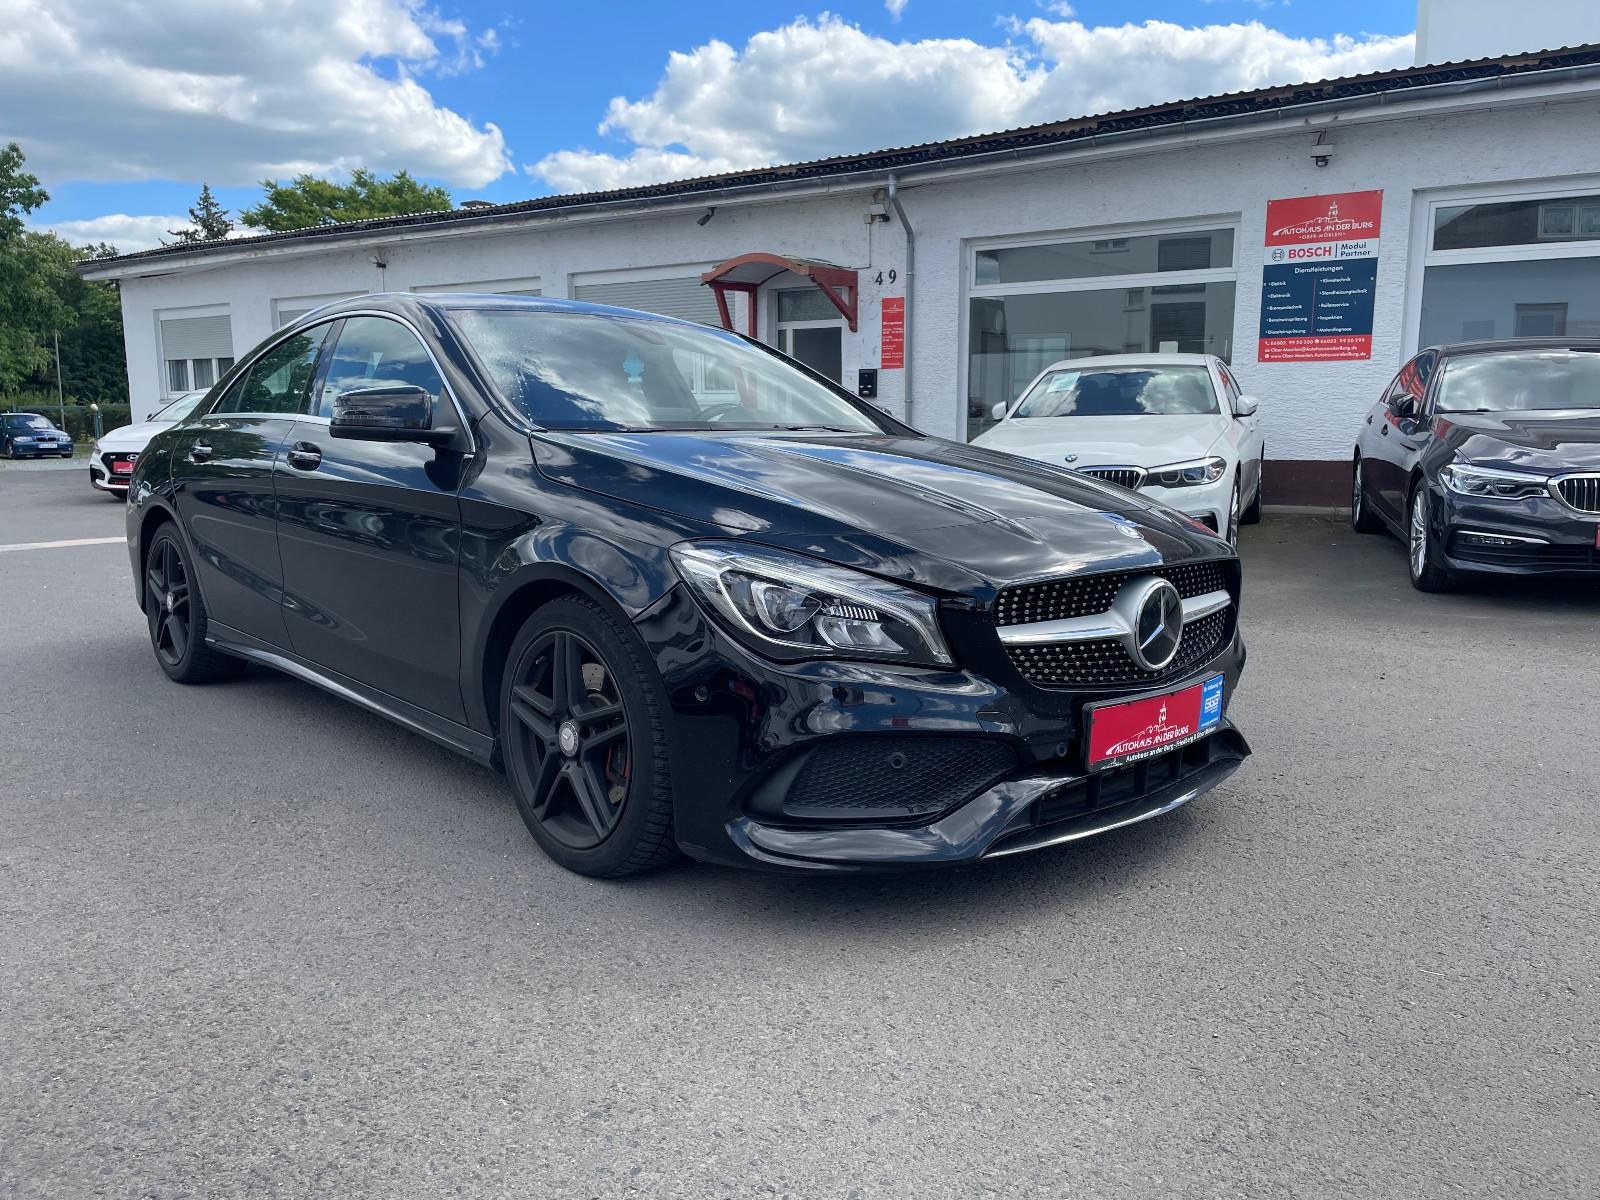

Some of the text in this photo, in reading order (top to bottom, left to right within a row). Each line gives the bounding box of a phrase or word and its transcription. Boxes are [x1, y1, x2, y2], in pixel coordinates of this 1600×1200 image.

[1281, 225, 1321, 236] AUTOHAUS
[1352, 221, 1373, 230] BURG
[1288, 246, 1332, 258] BOSCH
[1341, 242, 1366, 250] Modul
[875, 270, 896, 286] 49
[1114, 725, 1188, 754] AUTOHAUS AN DER BURG
[1126, 751, 1149, 762] Autohaus
[1164, 744, 1174, 752] Burg
